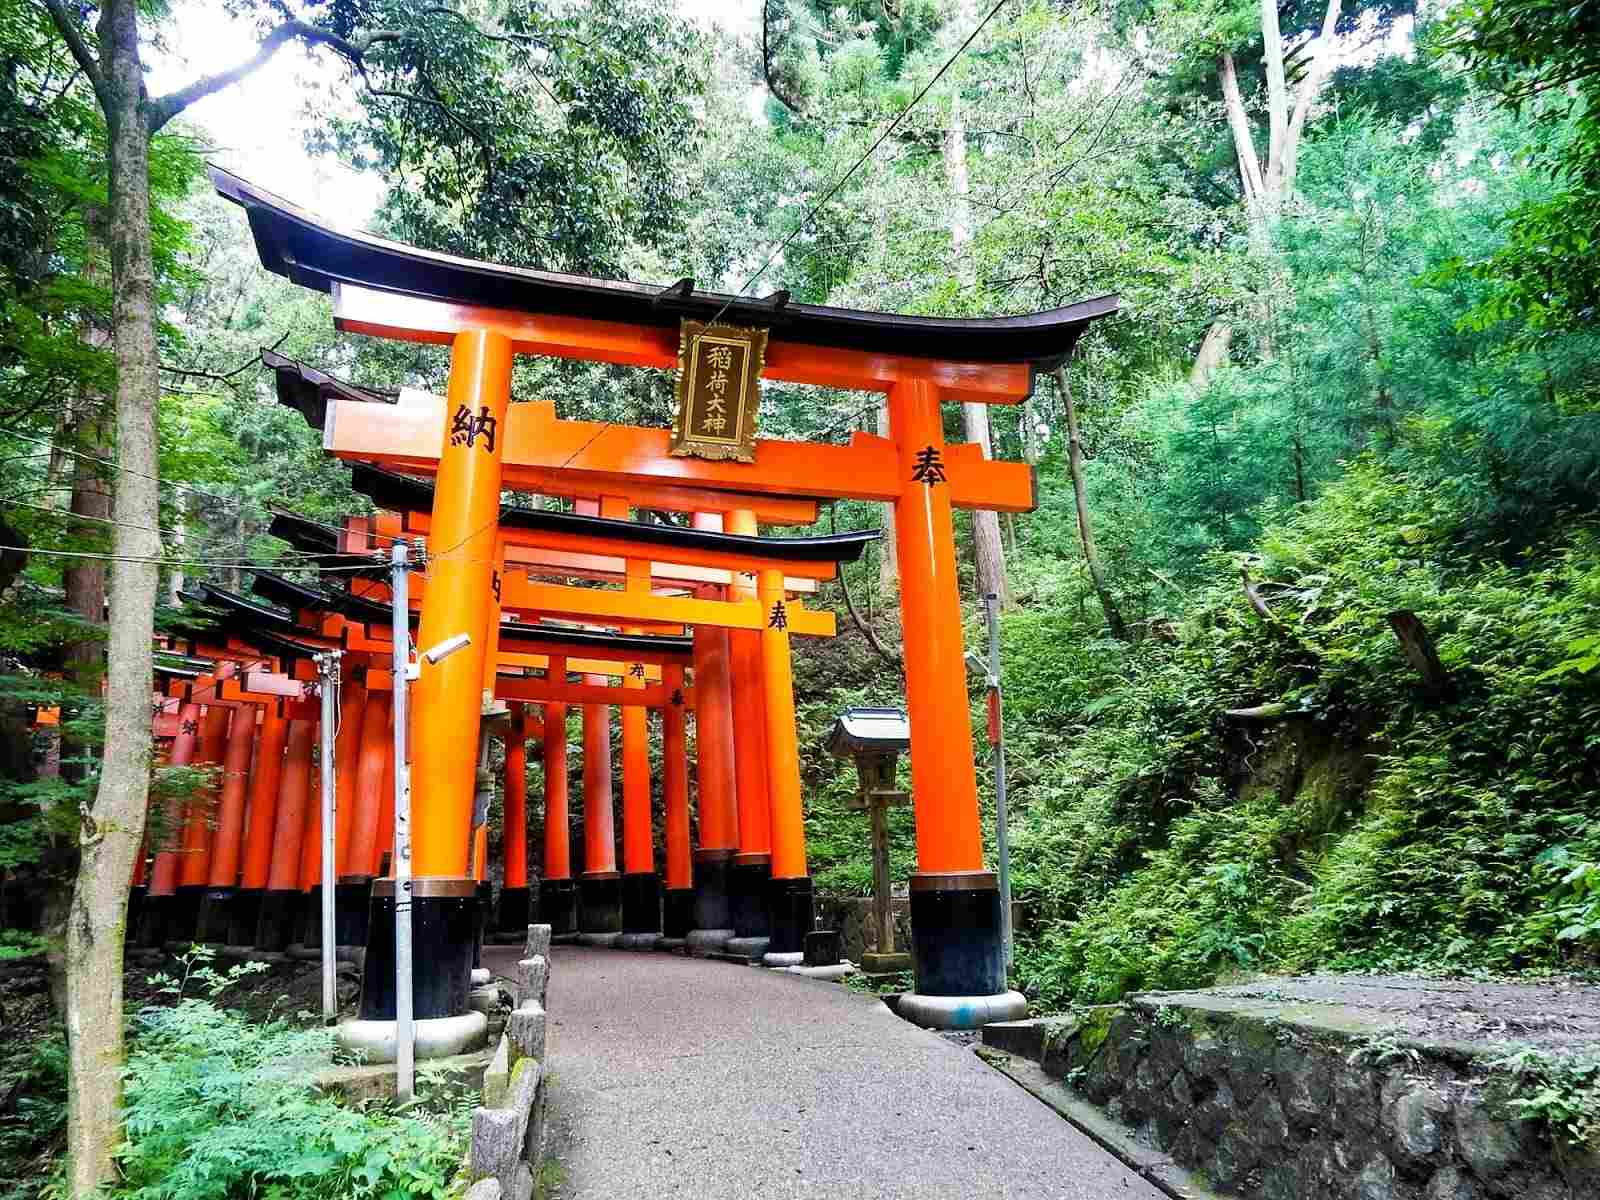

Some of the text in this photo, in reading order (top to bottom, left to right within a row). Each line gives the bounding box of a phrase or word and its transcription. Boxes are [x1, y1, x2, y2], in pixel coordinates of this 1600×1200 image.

[452, 404, 497, 453] 納
[911, 445, 947, 488] 奉
[768, 600, 787, 632] 奉
